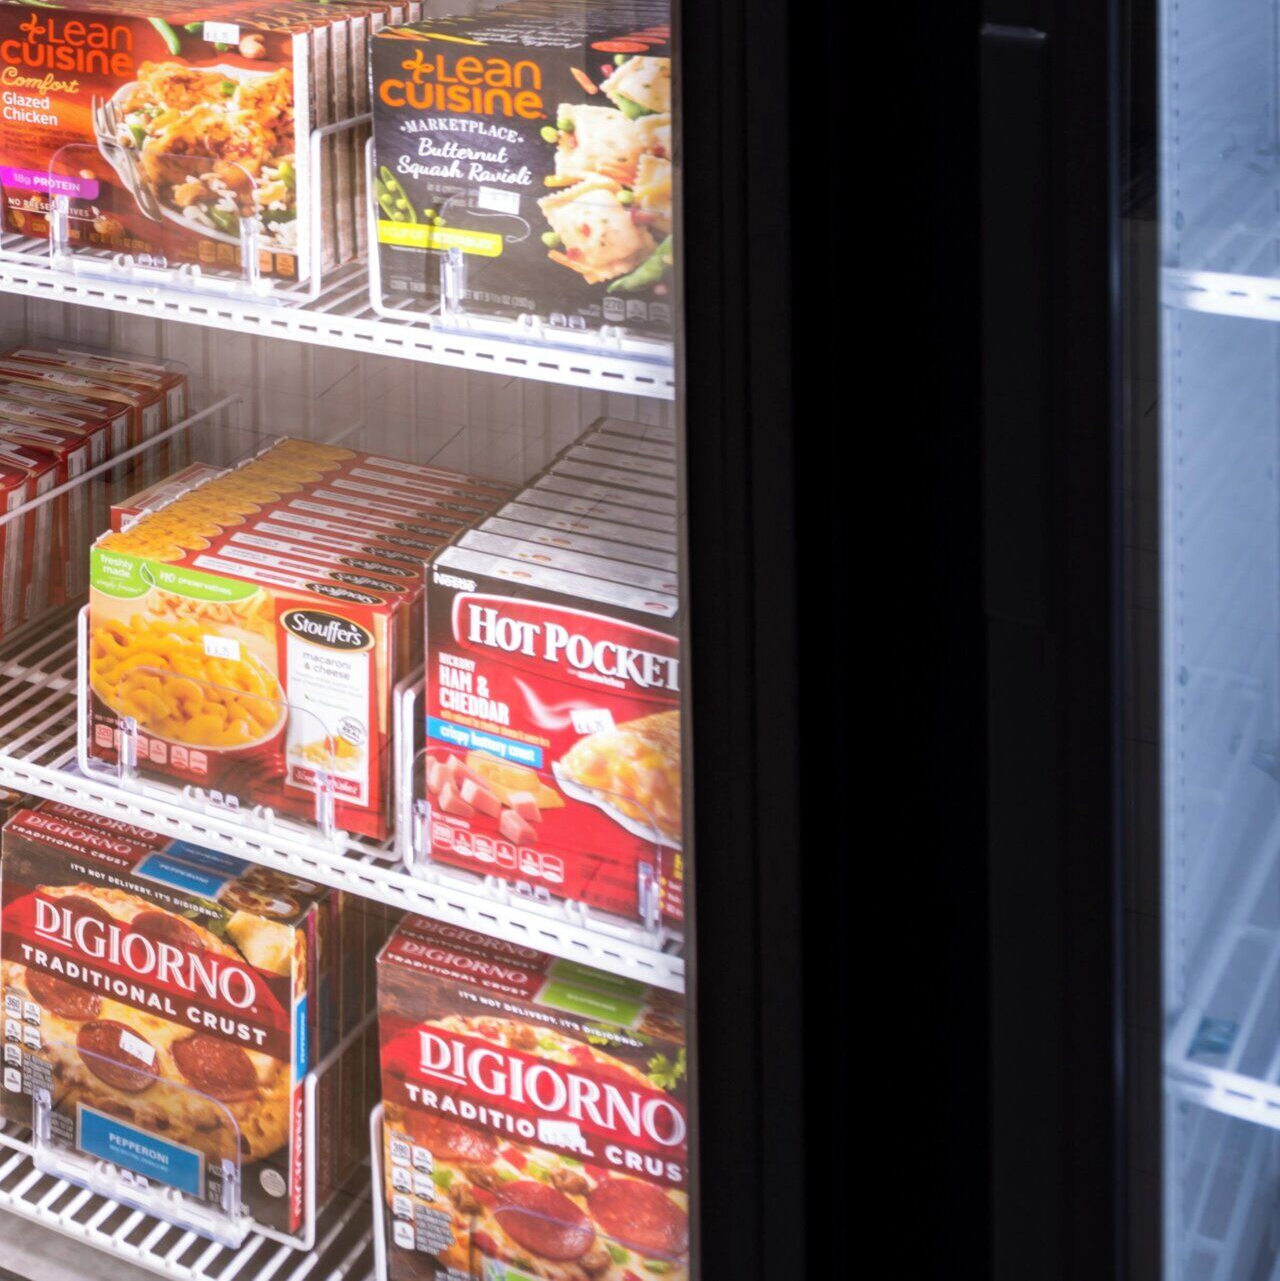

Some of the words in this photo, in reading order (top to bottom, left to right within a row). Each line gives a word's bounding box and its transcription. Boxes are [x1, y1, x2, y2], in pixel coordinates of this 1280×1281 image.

[47, 18, 134, 52] Lean
[1, 69, 79, 95] Comfort
[436, 54, 541, 90] Lean
[3, 92, 50, 111] Glazed
[3, 106, 59, 127] Chicken
[405, 118, 519, 143] MARKETPLACE
[418, 137, 509, 164] Butternut
[13, 173, 32, 190] 18g
[33, 176, 81, 194] PROTEIN
[397, 156, 464, 179] Squash
[468, 163, 533, 186] Ravioli
[7, 198, 21, 208] NO
[100, 553, 133, 571] freshly
[102, 566, 132, 579] made
[291, 612, 363, 648] Stouffer's
[467, 604, 541, 657] HOT
[302, 651, 352, 670] macaroni
[304, 662, 312, 671] &
[313, 664, 352, 681] cheese
[439, 663, 473, 688] HAM
[476, 675, 490, 698] &
[439, 687, 511, 726] CHEDDAR
[440, 725, 470, 747] crispy
[470, 731, 507, 758] buttery
[508, 744, 536, 762] crust
[12, 824, 87, 854] TRADITIONAL
[91, 849, 130, 867] CRUST
[71, 863, 86, 874] IT'S
[88, 868, 106, 879] NOT
[108, 873, 154, 897] DELIVERY.
[155, 890, 171, 903] IT'S
[387, 952, 478, 986] TRADITIONAL
[482, 979, 529, 998] CRUST
[21, 941, 177, 1015] TRADITIONAL
[186, 1006, 268, 1047] CRUST
[458, 989, 477, 1002] IT'S
[480, 996, 502, 1010] NOT
[560, 1018, 580, 1031] IT'S
[108, 1131, 169, 1166] PEPPERONI
[604, 1144, 683, 1183] CRUS
